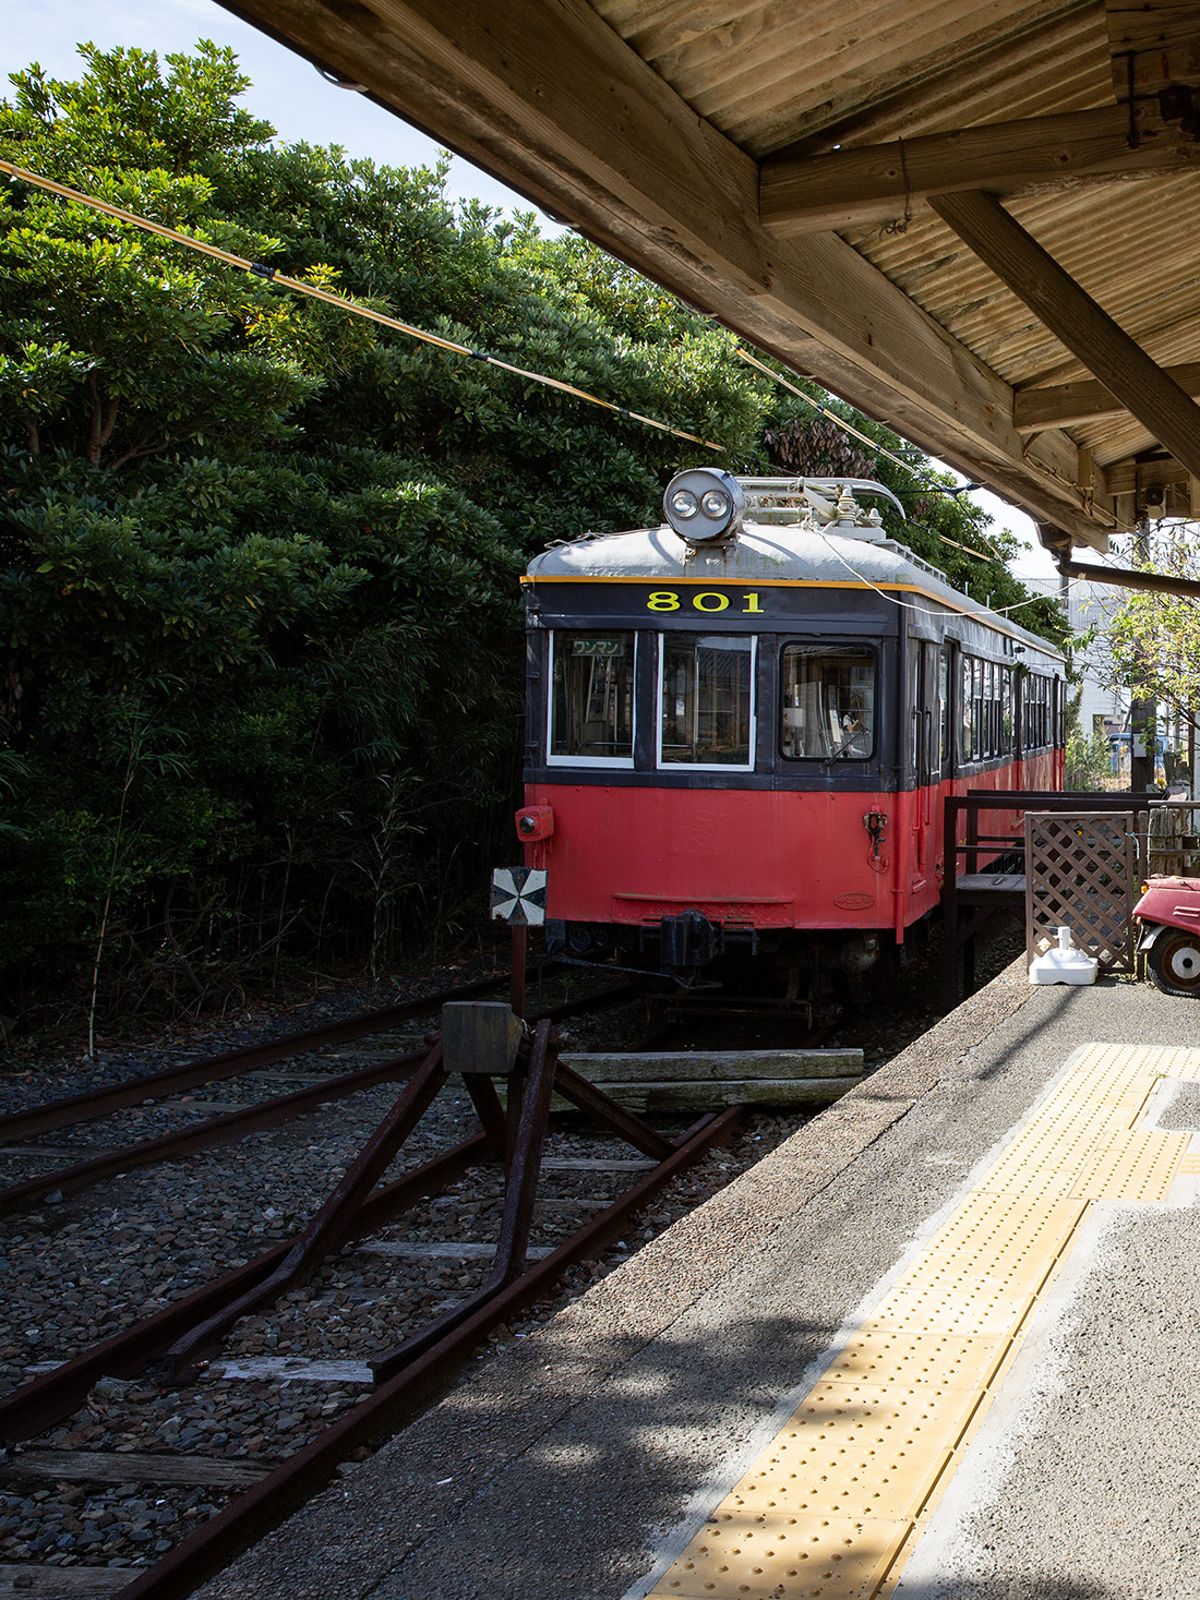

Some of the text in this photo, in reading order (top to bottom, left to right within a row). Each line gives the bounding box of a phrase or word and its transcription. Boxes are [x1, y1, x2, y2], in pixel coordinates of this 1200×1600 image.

[647, 591, 765, 613] 801
[573, 640, 618, 655] ワンマン
